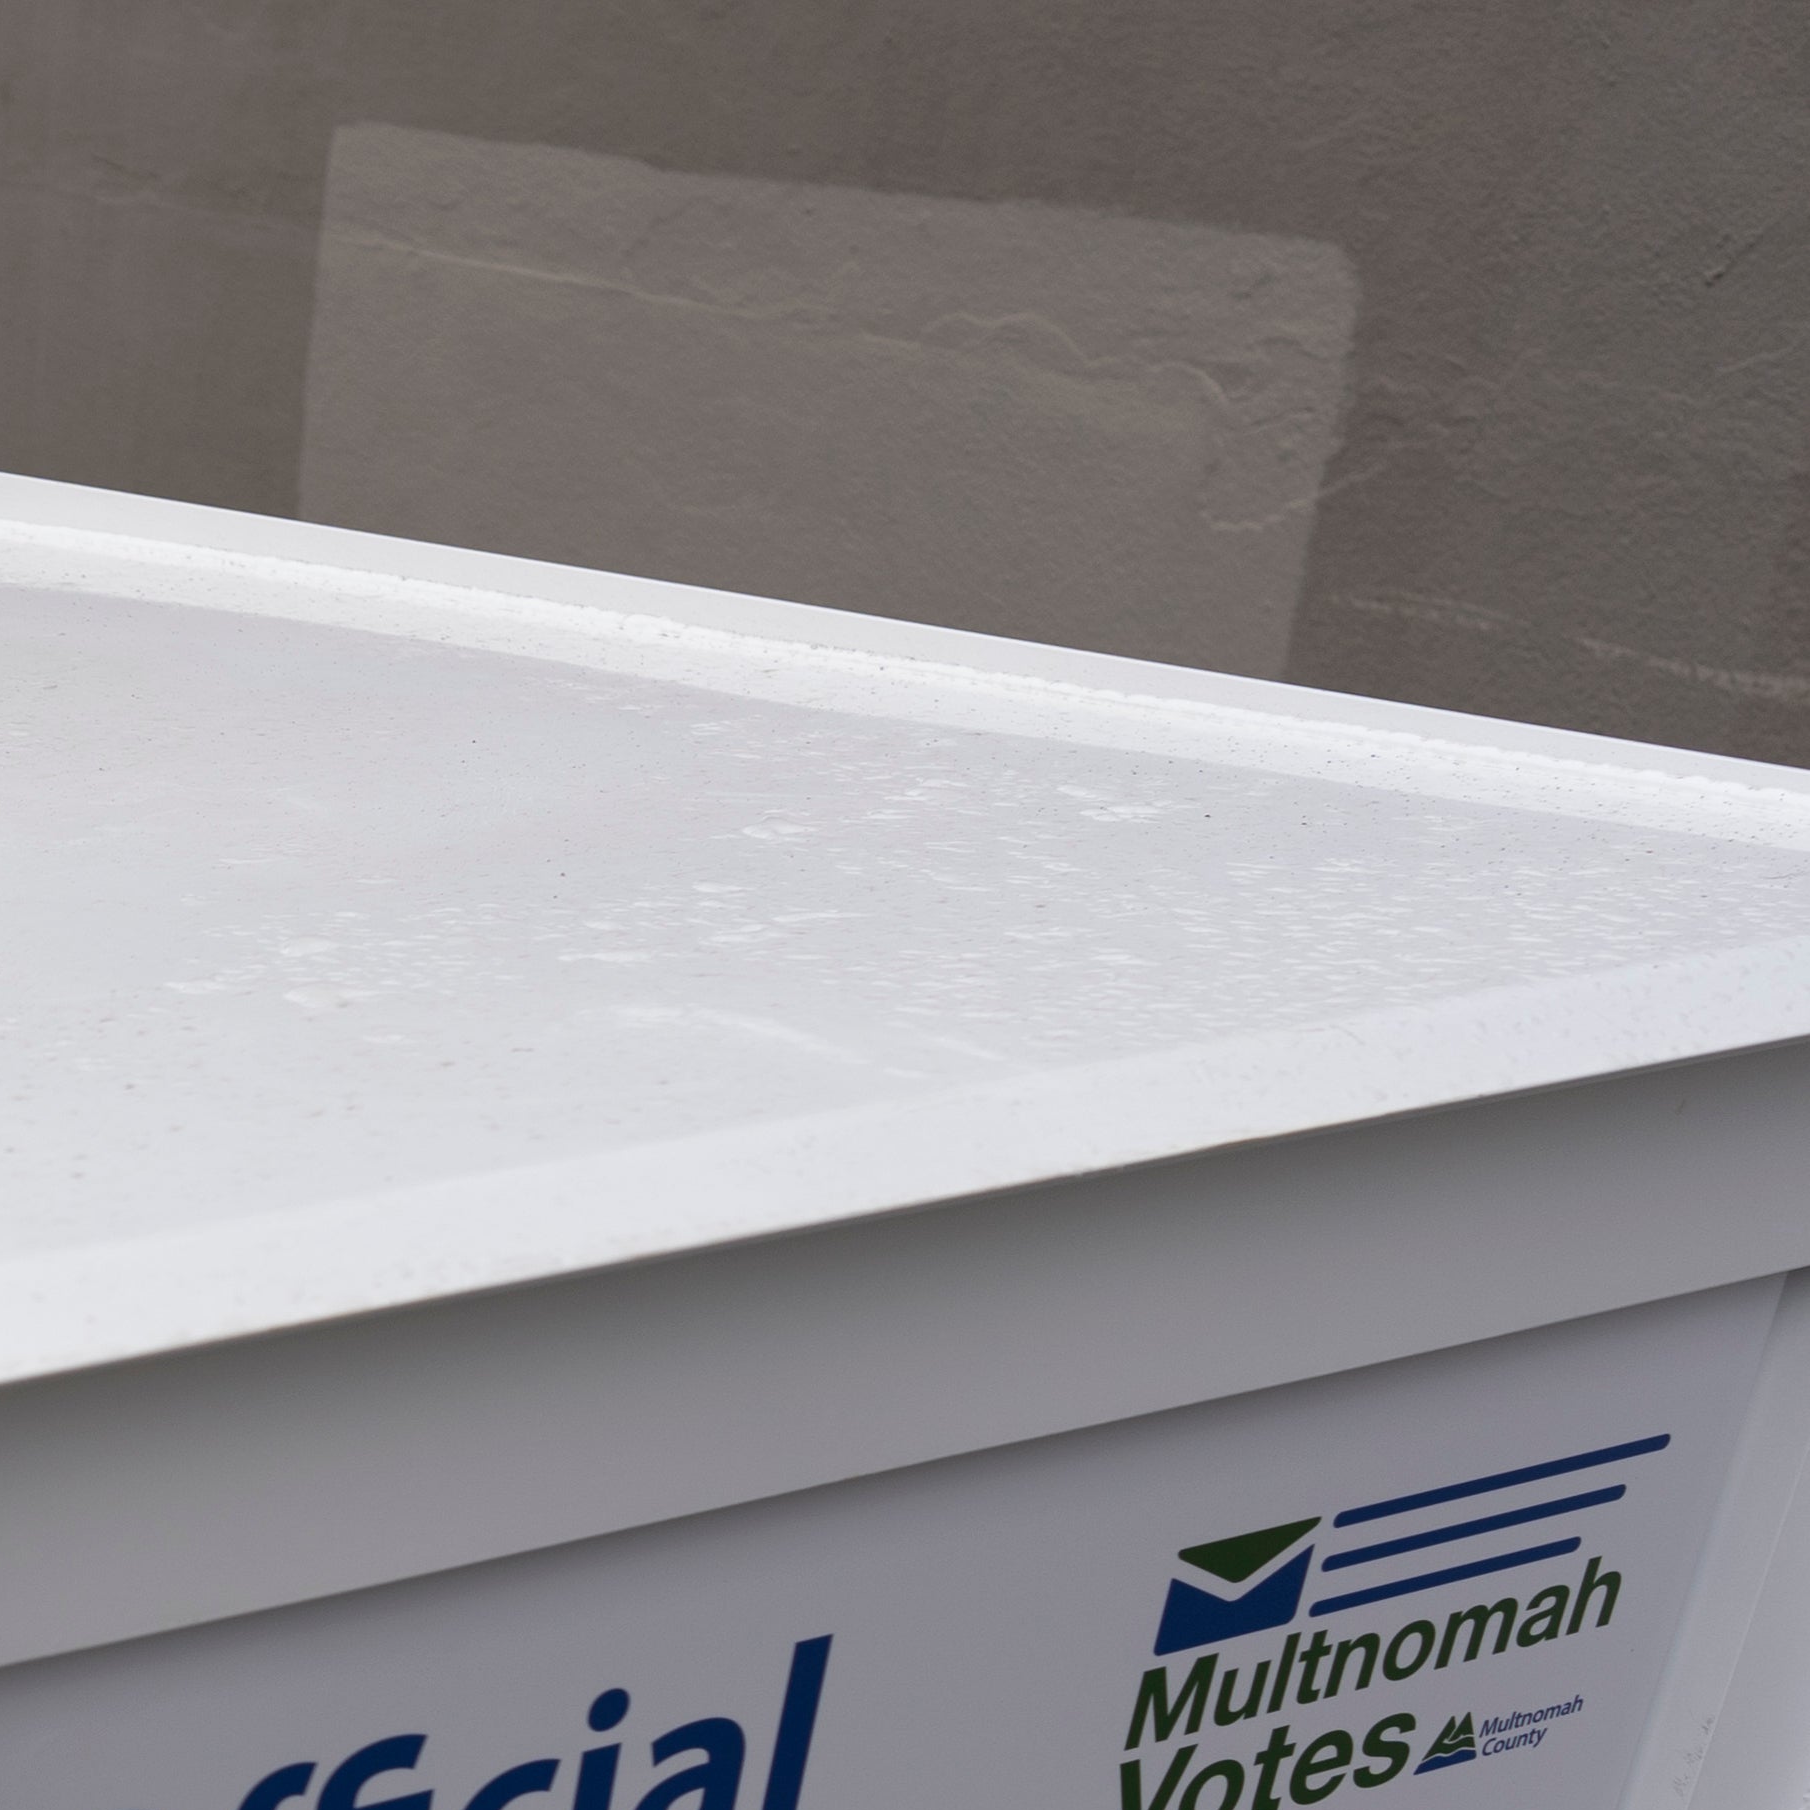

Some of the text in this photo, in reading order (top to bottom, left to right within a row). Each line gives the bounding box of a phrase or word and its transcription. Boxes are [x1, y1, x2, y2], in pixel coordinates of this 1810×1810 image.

[1123, 1555, 1622, 1751] Multnomah
[1480, 1695, 1584, 1739] Multnomah
[1482, 1725, 1547, 1757] County
